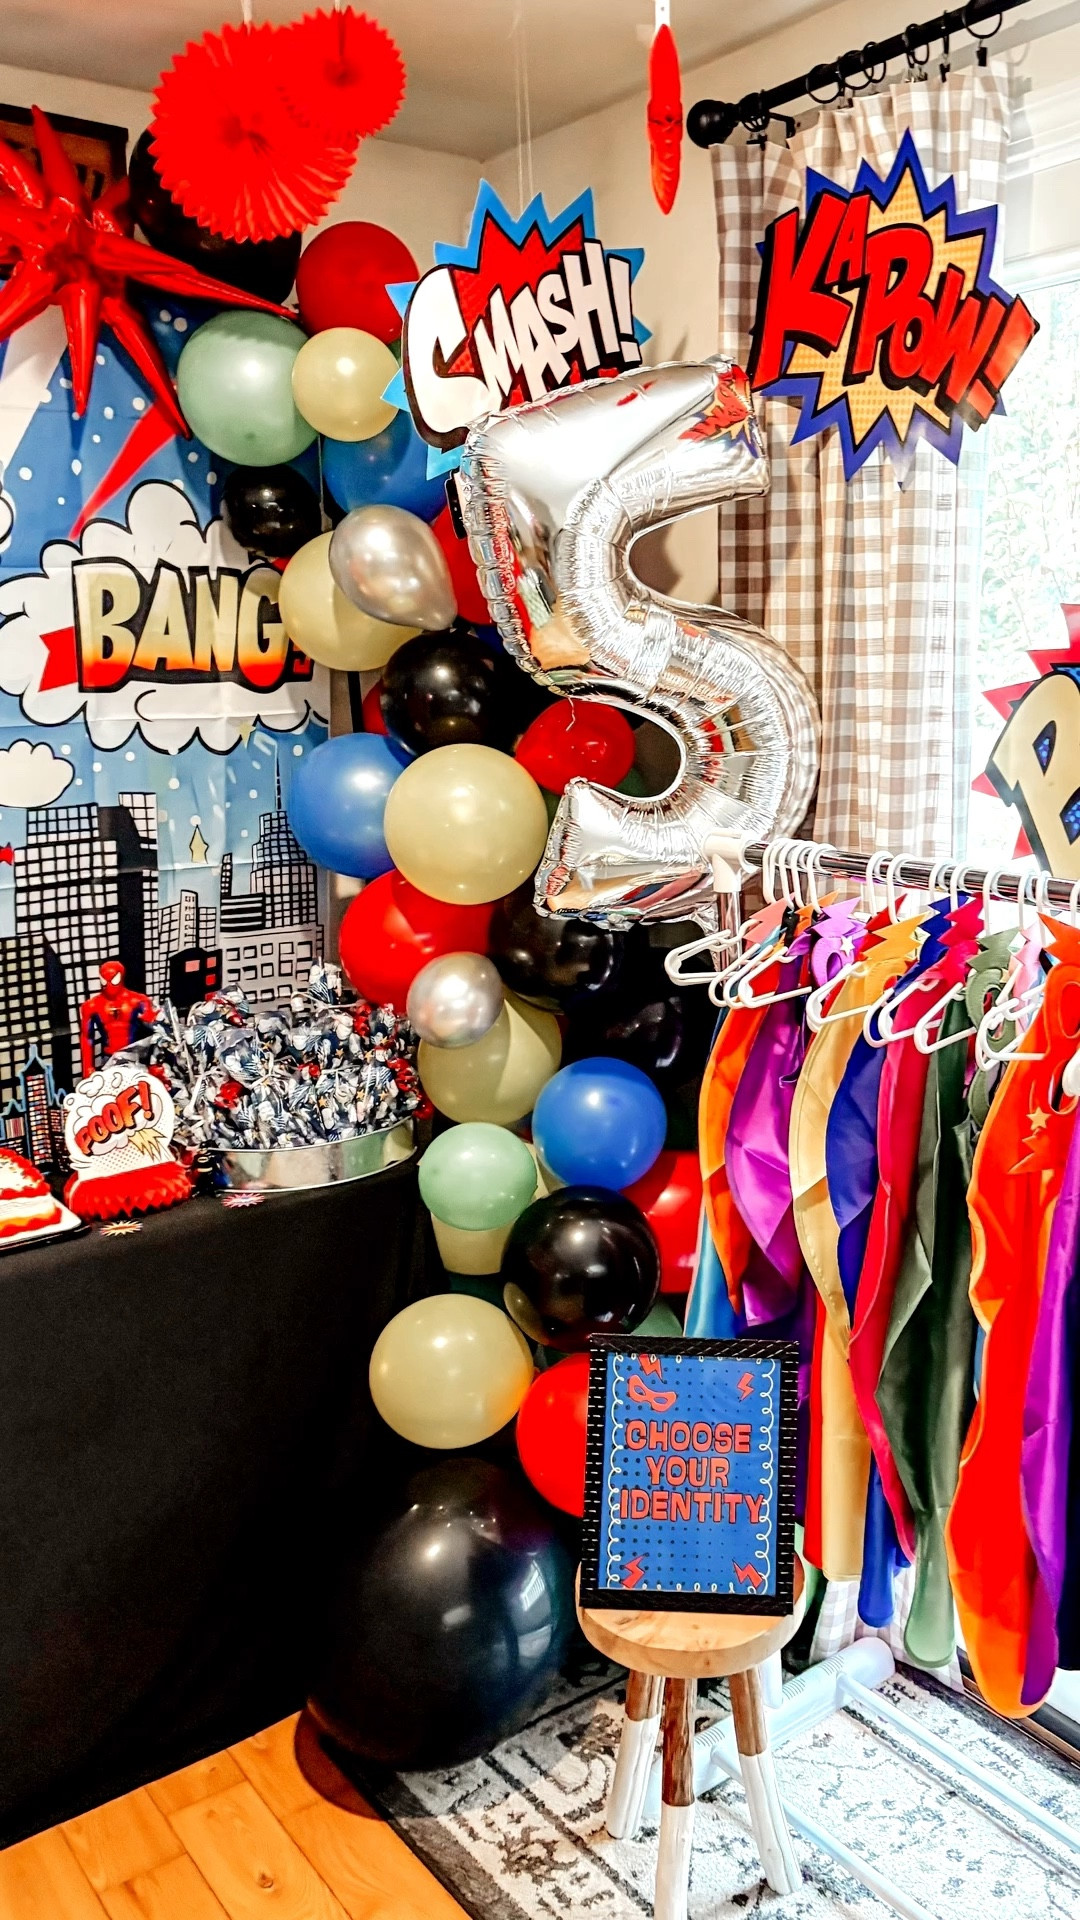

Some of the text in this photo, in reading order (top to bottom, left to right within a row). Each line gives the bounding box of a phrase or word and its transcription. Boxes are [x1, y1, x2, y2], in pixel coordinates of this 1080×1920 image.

[72, 557, 312, 692] BANG
[75, 1081, 154, 1156] POOF!
[625, 1419, 752, 1453] CHOOSE
[646, 1455, 731, 1488] YOUR
[619, 1489, 764, 1523] IDENTITY
